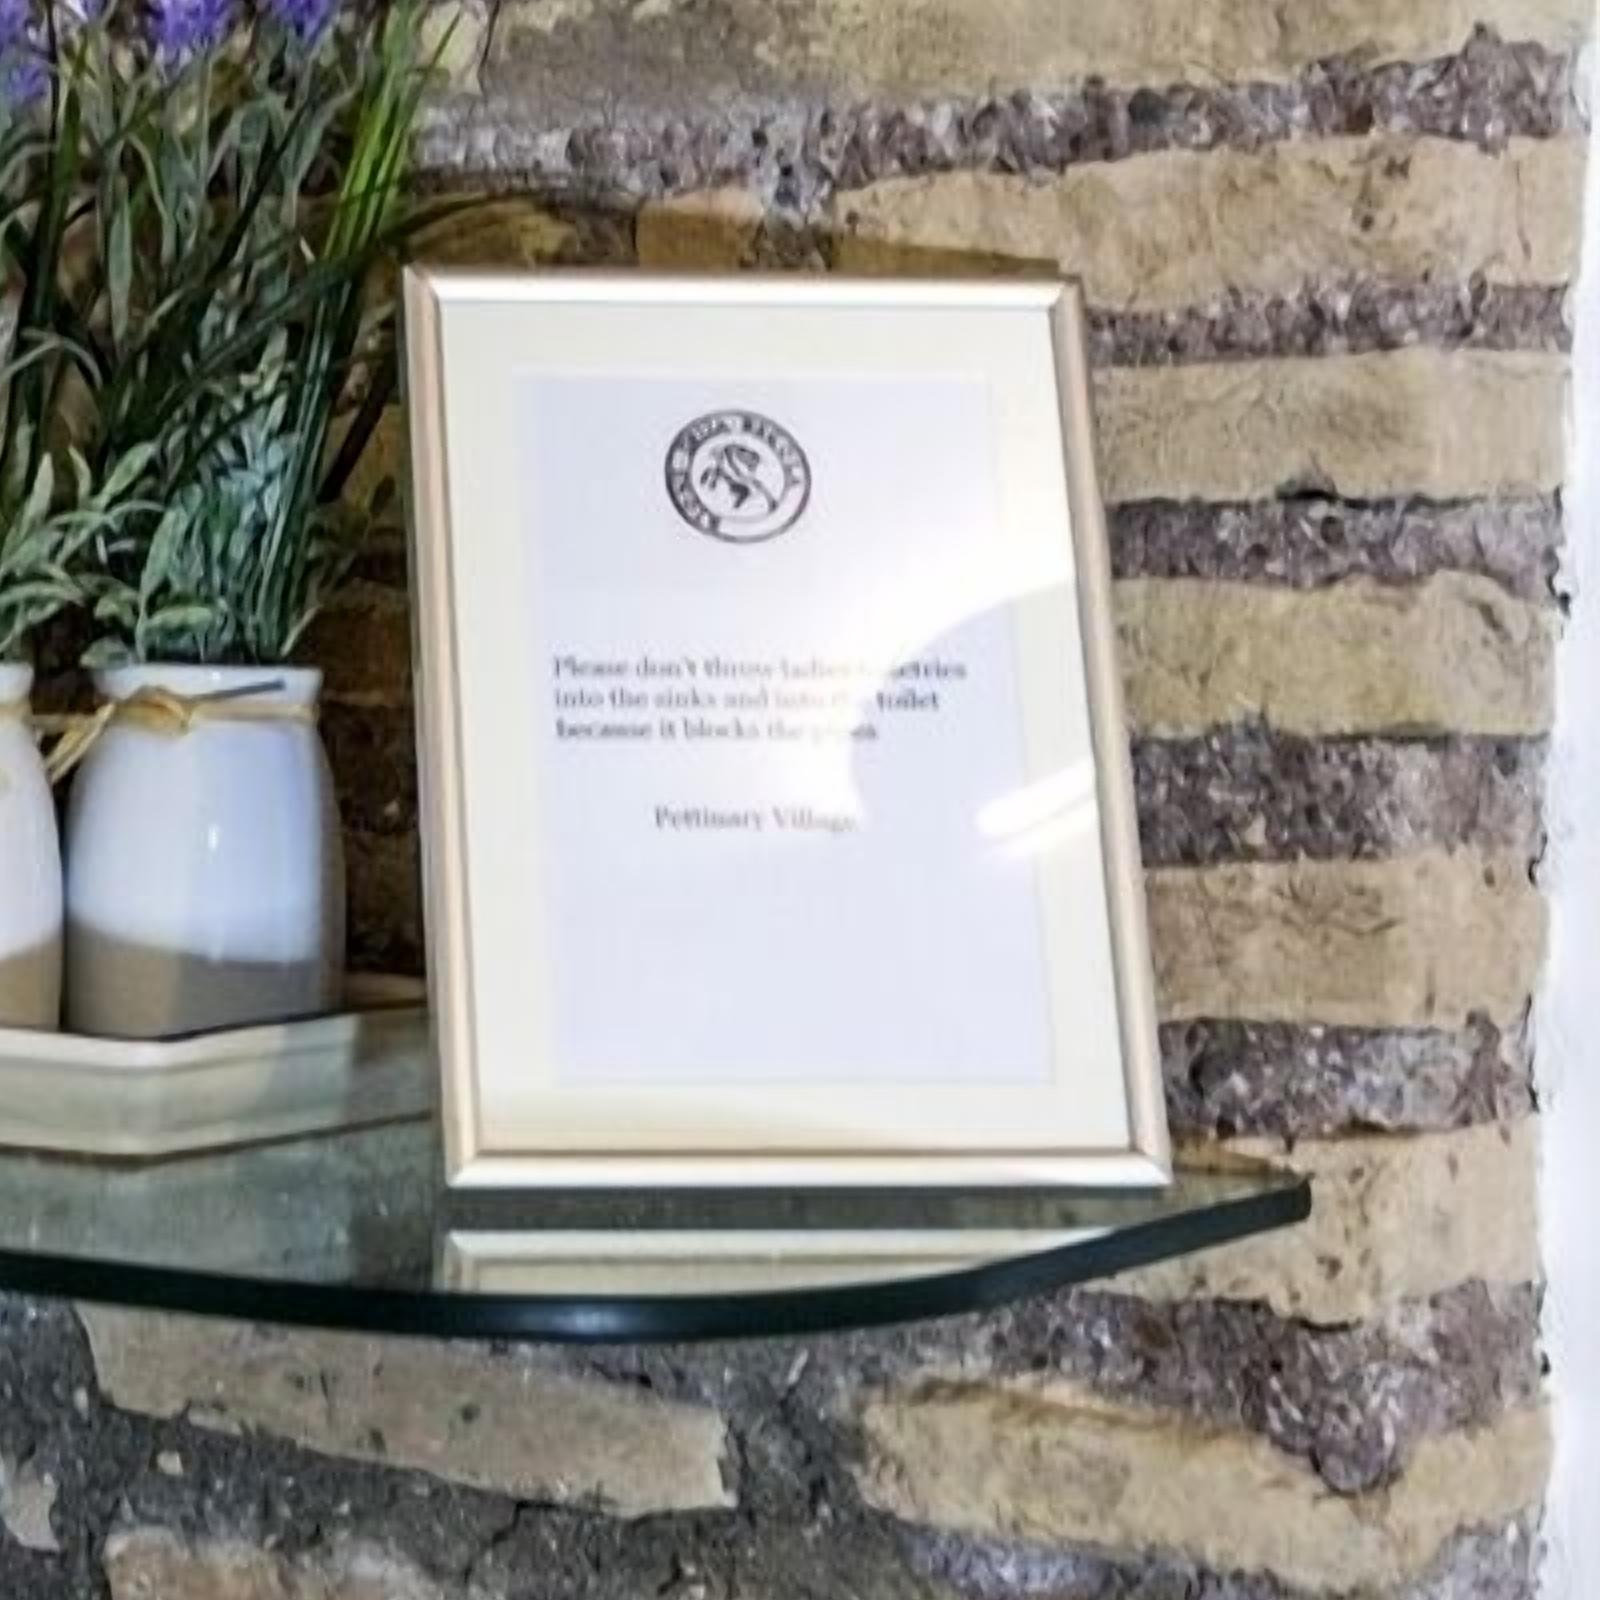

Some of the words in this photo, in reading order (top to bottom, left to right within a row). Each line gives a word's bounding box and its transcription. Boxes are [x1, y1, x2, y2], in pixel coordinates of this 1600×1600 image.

[553, 656, 628, 679] Please
[635, 656, 696, 679] don't
[703, 656, 773, 680] throw
[554, 688, 604, 710] into
[608, 688, 648, 710] the
[653, 688, 718, 710] sinks
[723, 688, 769, 710] and
[875, 689, 940, 712] toilet
[555, 718, 653, 740] because
[659, 718, 677, 740] it
[682, 718, 761, 741] blocks
